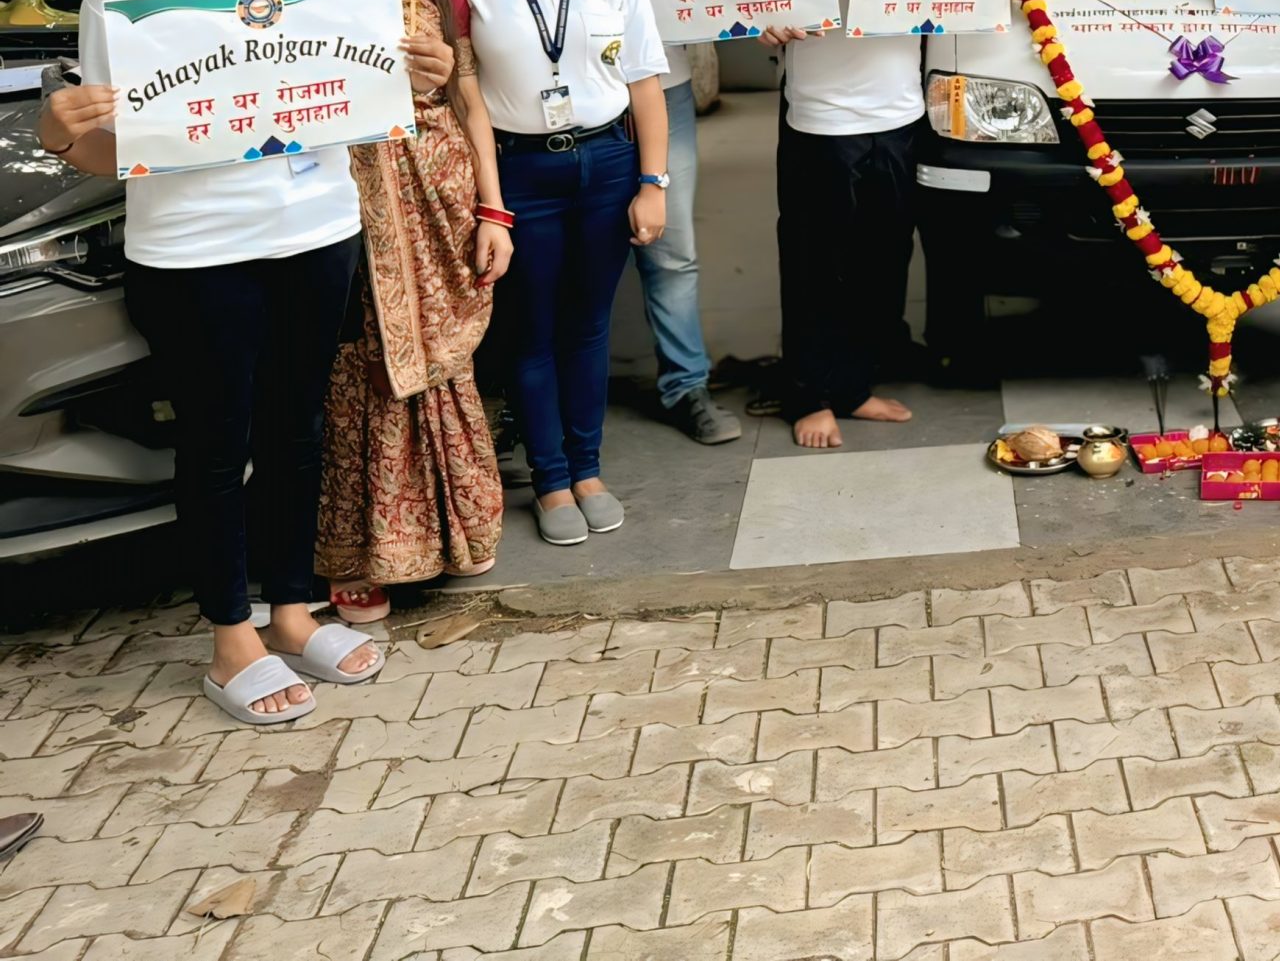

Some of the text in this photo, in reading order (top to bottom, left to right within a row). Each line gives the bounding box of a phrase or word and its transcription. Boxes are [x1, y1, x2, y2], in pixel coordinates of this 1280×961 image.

[705, 5, 724, 18] घर
[127, 34, 396, 112] Sahayak Rojgar India
[187, 78, 347, 118] घर घर रोजगार
[186, 100, 351, 144] हर घर खुशहाल
